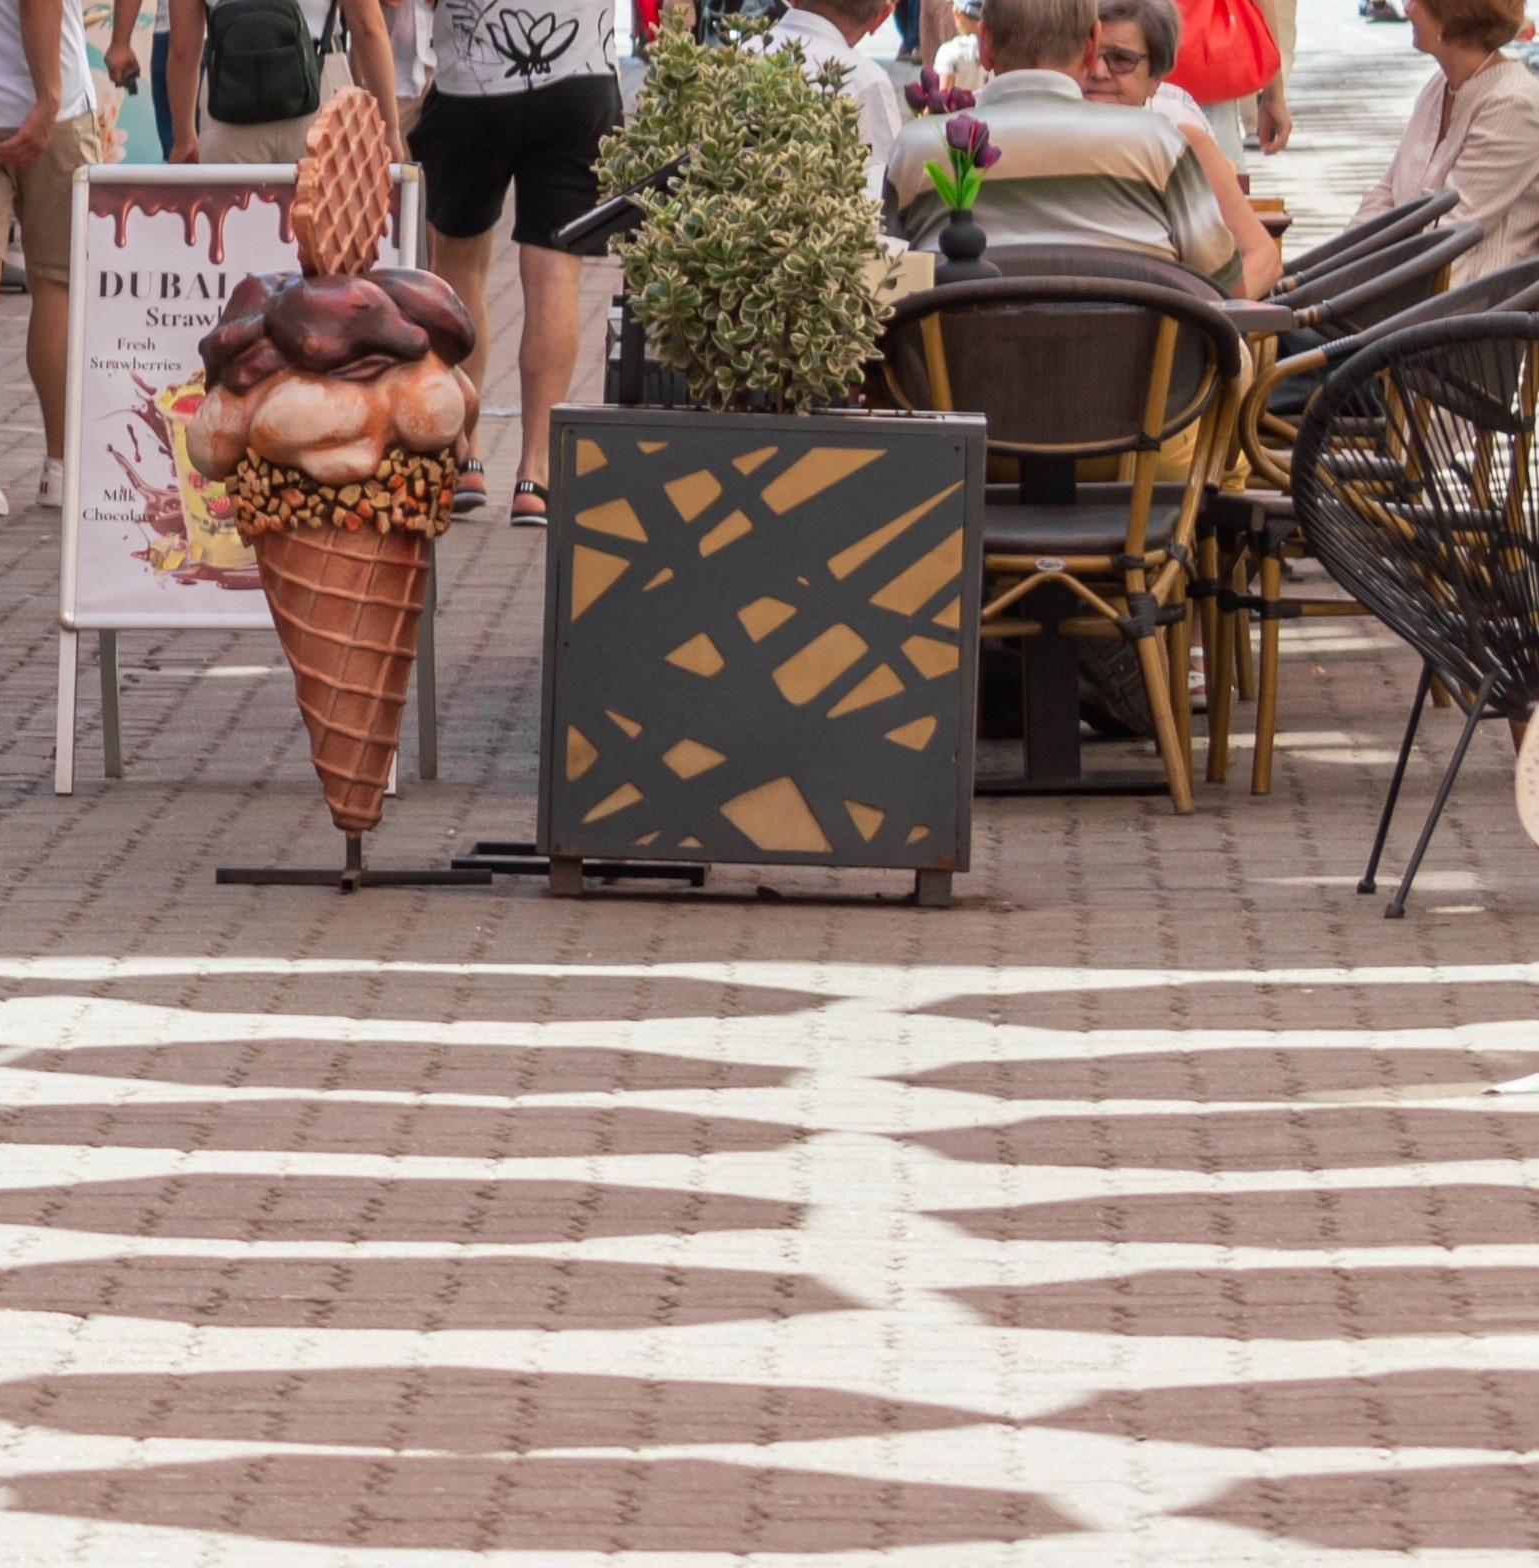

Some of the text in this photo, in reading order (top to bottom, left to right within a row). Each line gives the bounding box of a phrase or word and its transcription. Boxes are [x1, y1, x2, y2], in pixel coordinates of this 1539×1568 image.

[99, 270, 228, 299] DUBAI
[116, 336, 156, 351] Fresh
[90, 355, 182, 372] Strawberries
[103, 485, 136, 502] Milk
